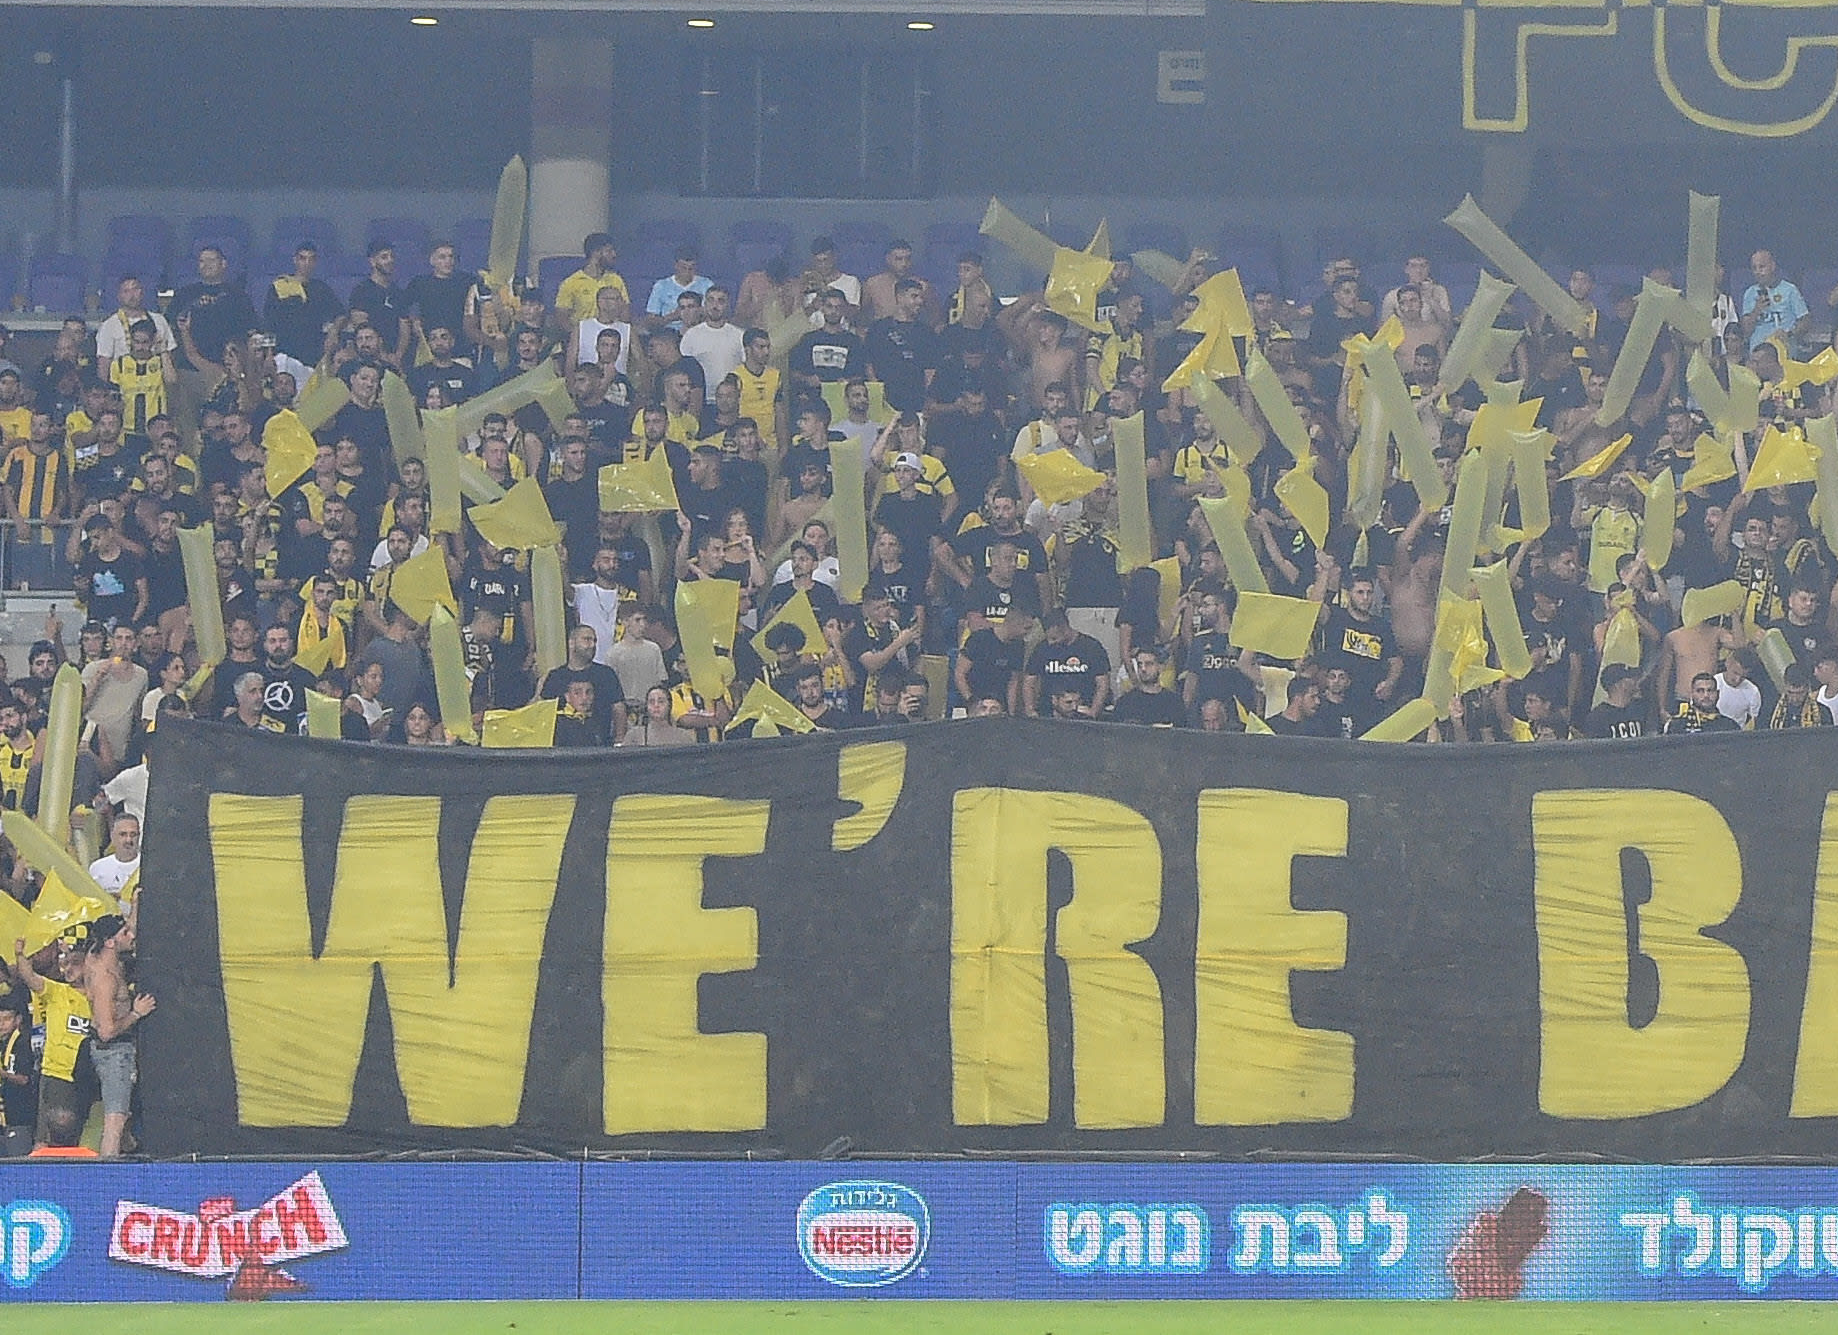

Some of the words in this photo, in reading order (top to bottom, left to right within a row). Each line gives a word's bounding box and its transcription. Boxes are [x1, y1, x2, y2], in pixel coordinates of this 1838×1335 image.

[208, 741, 1356, 1135] WE'RE
[119, 1185, 328, 1268] CRUNCH
[1051, 1210, 1201, 1267] נוגט
[1237, 1195, 1408, 1267] ליבת
